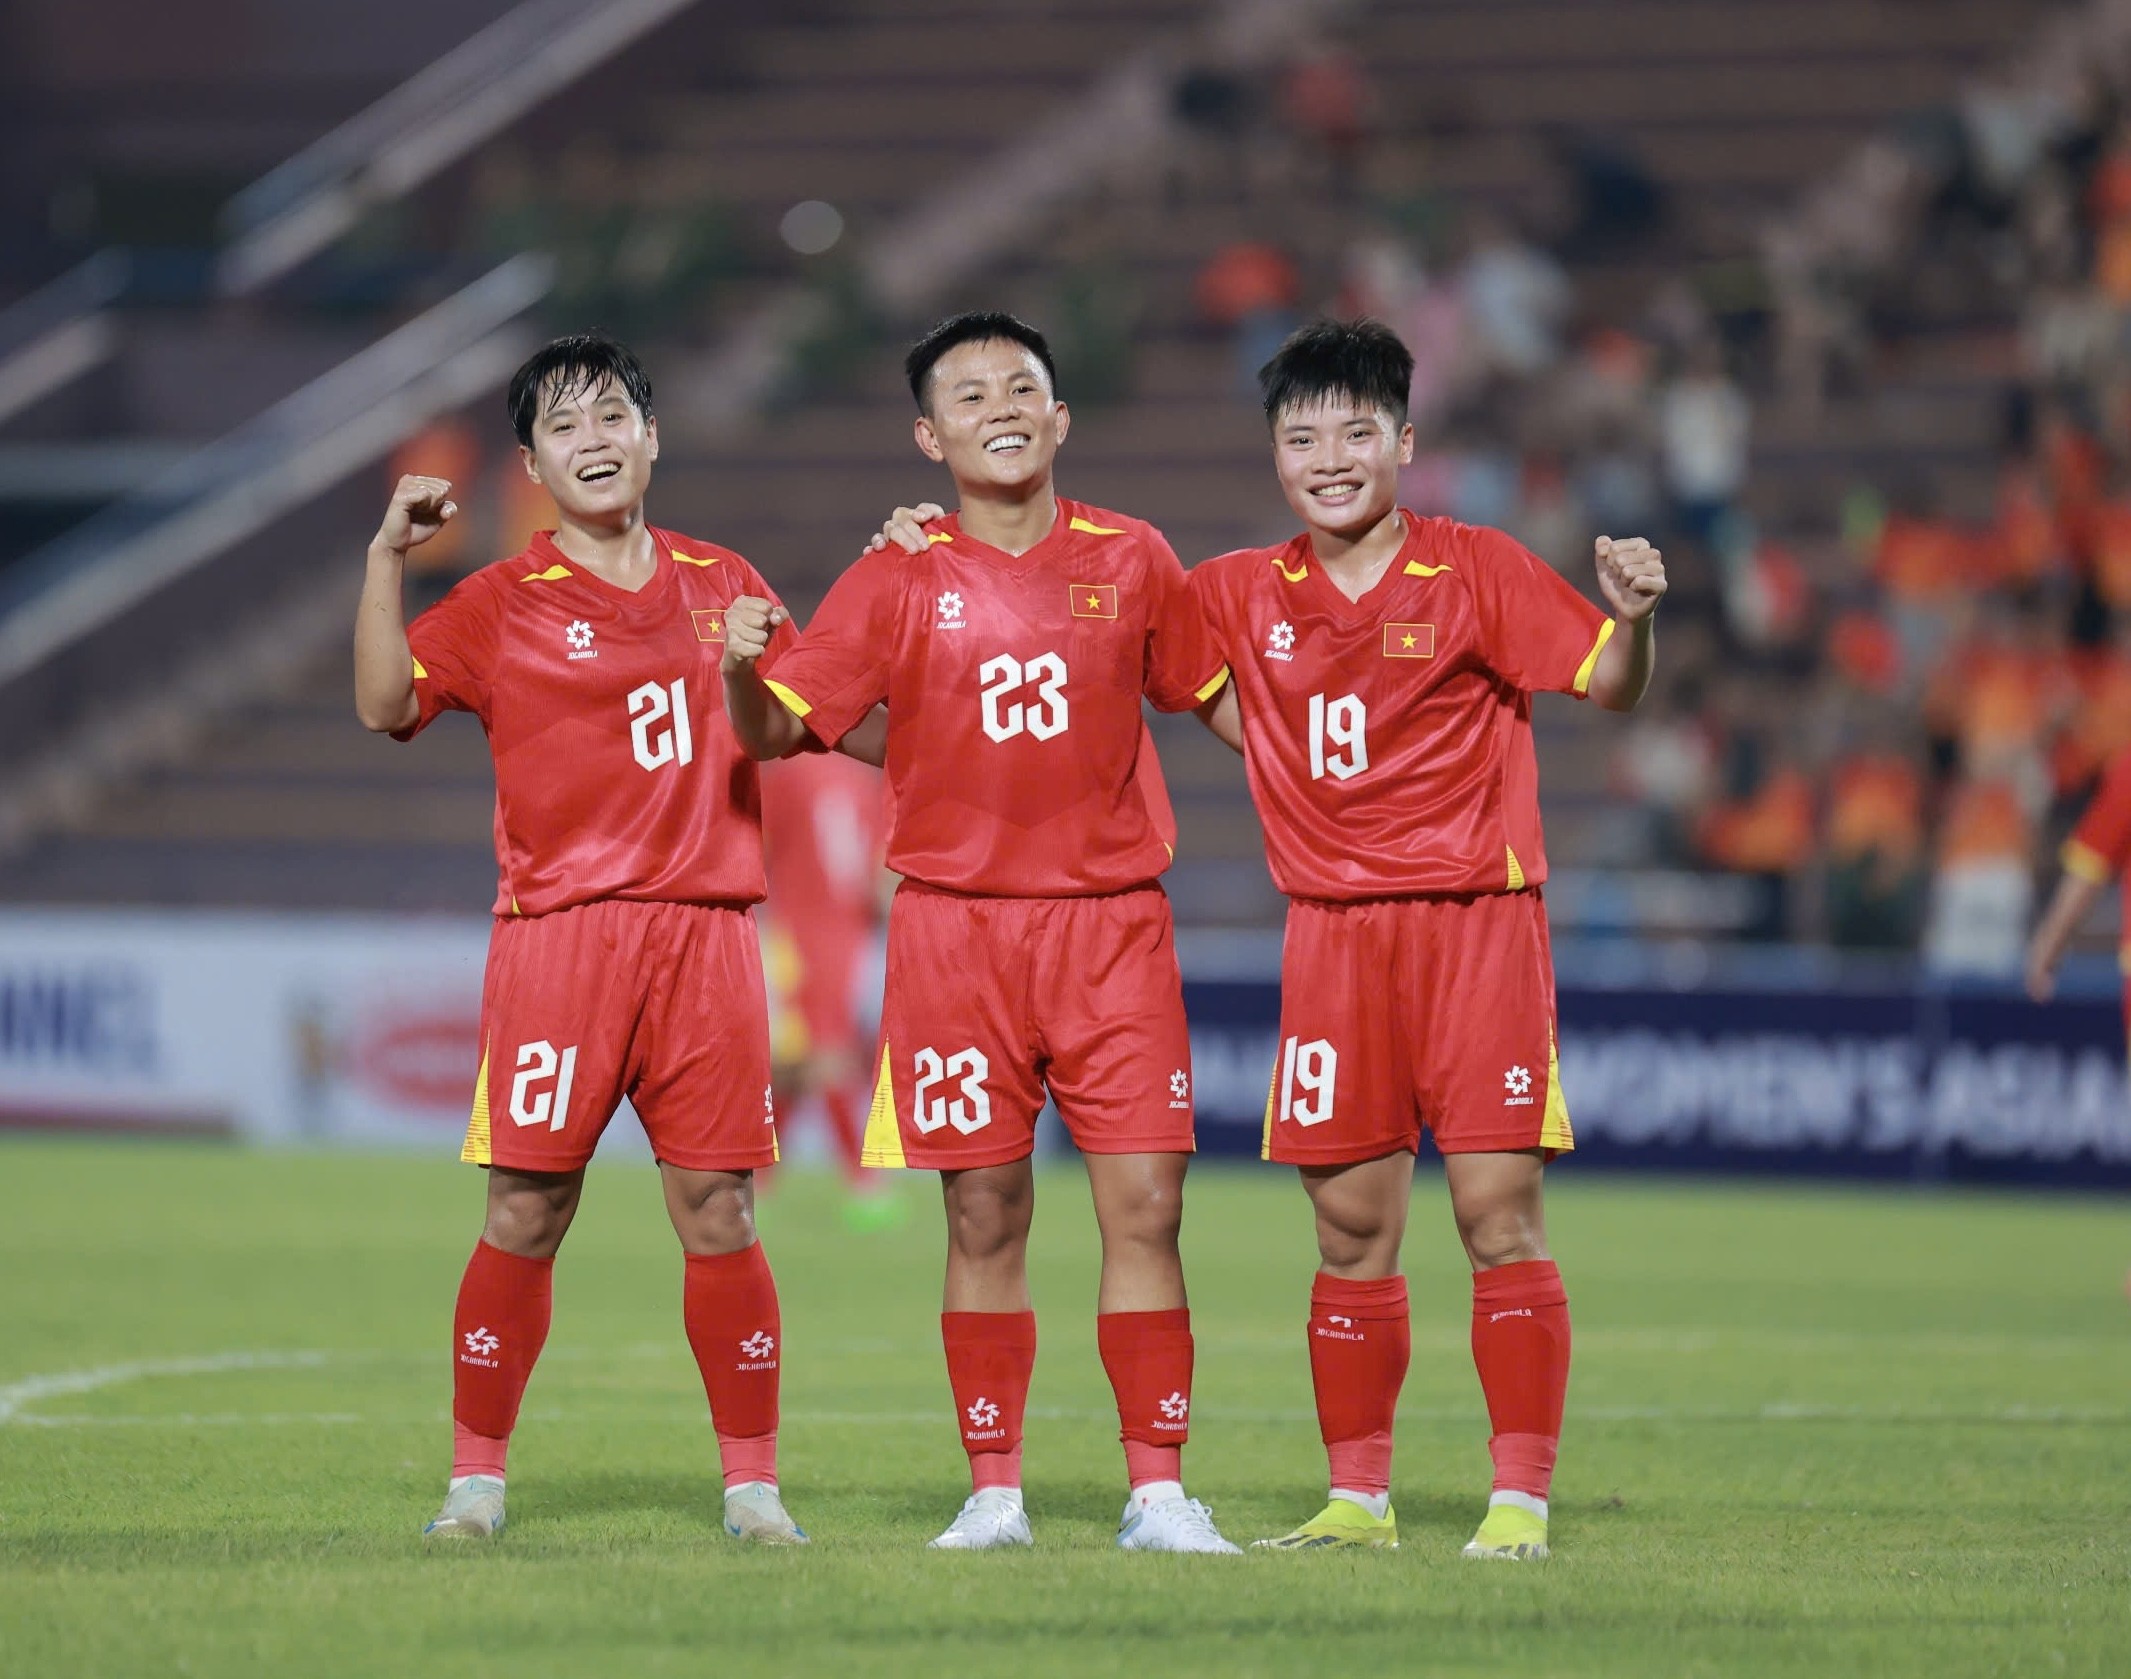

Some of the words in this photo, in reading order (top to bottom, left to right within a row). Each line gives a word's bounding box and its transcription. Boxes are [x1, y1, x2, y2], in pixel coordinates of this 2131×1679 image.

[627, 676, 693, 772] 21
[979, 651, 1069, 743] 23
[1308, 692, 1369, 781] 19
[508, 1039, 578, 1133] 21
[913, 1046, 992, 1136] 23
[1279, 1035, 1338, 1128] 19
